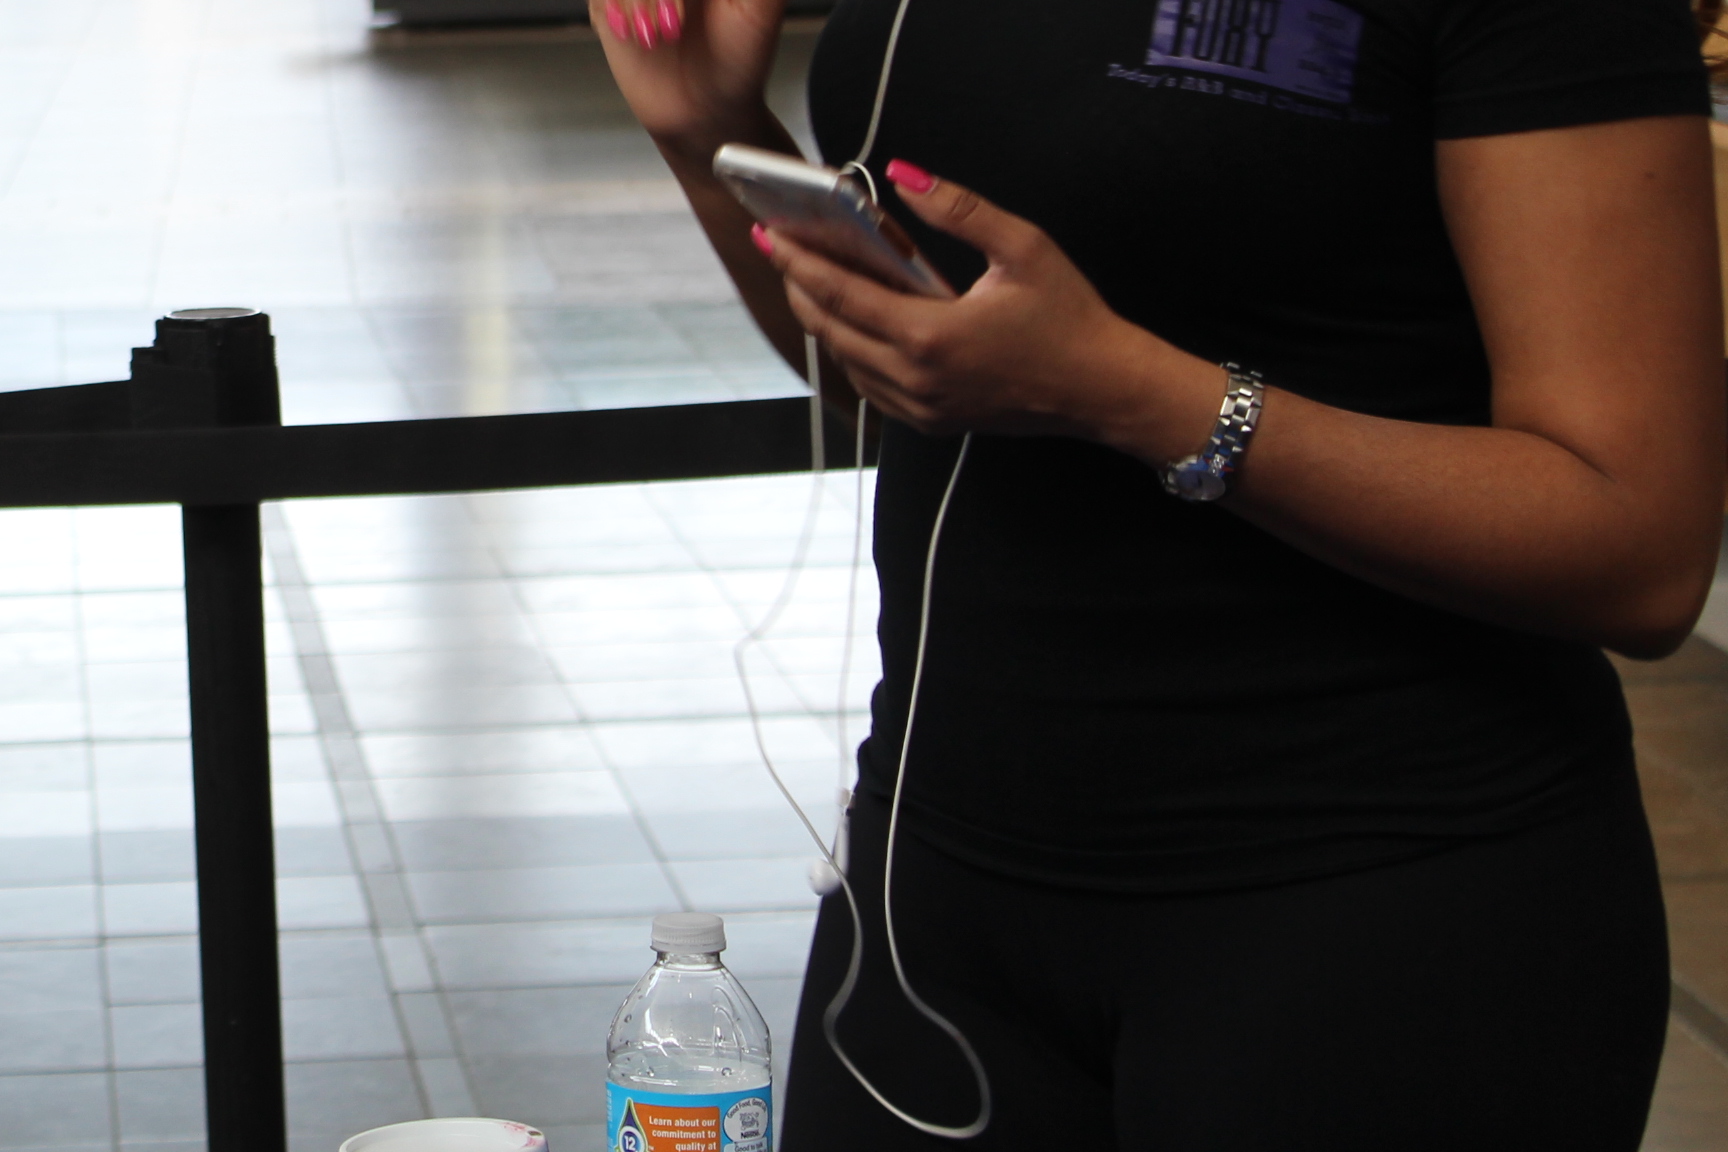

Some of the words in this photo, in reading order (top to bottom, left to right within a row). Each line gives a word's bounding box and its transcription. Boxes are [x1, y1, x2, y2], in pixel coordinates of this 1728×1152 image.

[649, 1115, 672, 1126] Learn
[674, 1118, 700, 1127] about
[701, 1119, 716, 1127] our
[652, 1129, 706, 1139] commitment
[707, 1130, 717, 1138] to
[675, 1142, 706, 1152] quality
[707, 1142, 717, 1150] at
